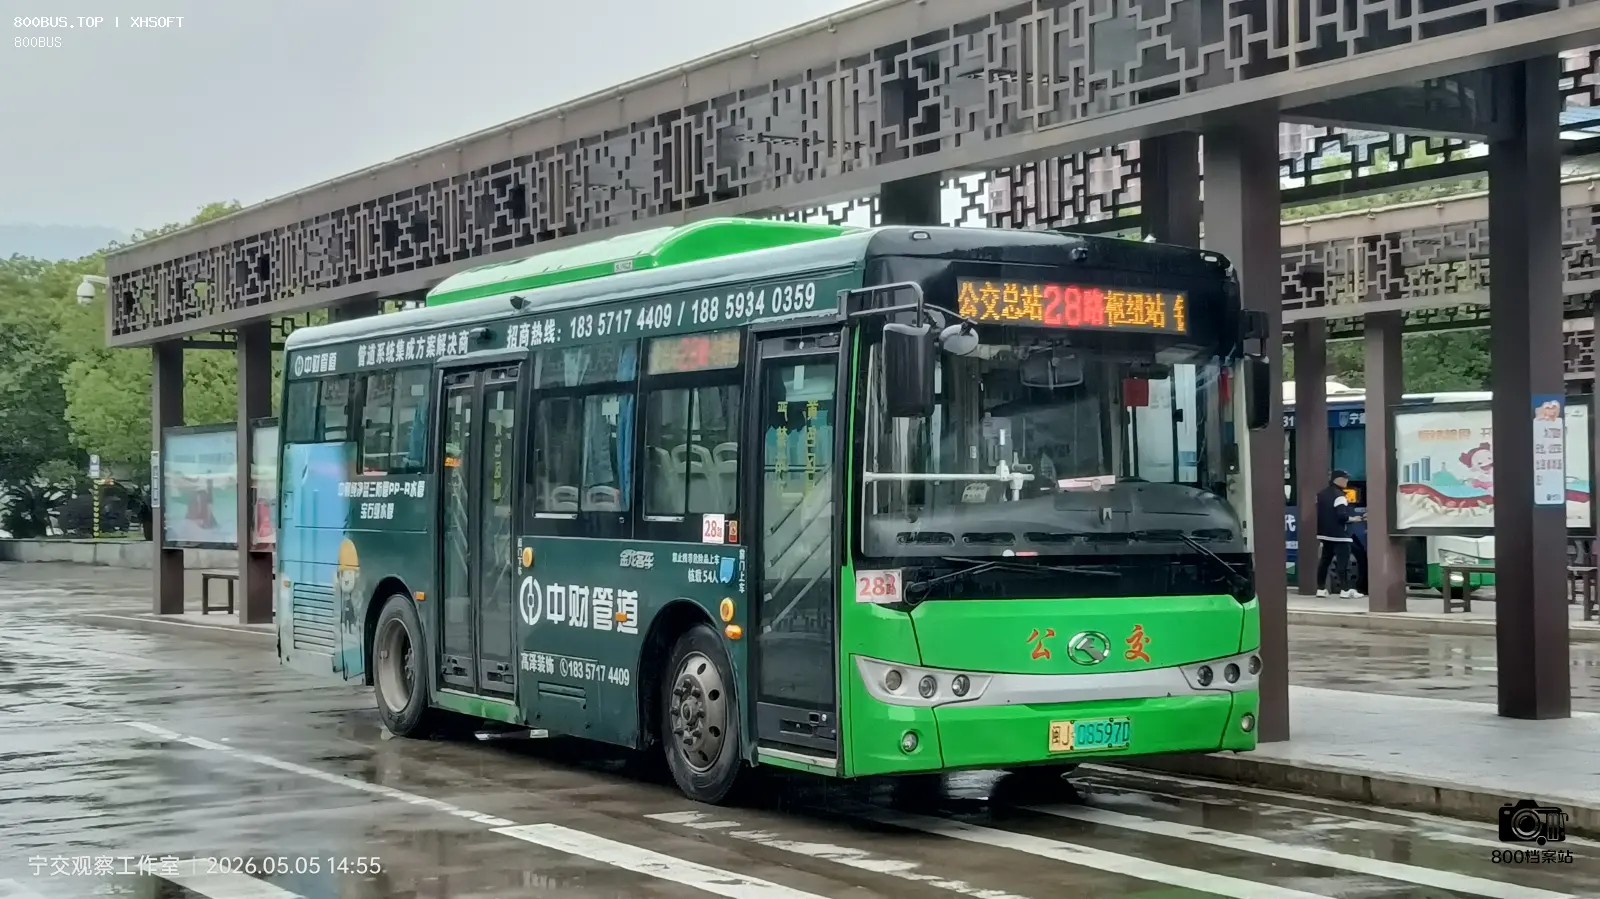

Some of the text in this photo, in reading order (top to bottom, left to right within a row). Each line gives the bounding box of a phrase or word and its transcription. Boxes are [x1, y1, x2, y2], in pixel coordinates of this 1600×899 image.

[570, 313, 593, 339] 183
[597, 308, 632, 336] 5717
[637, 303, 672, 331] 4409
[692, 295, 719, 324] 188
[725, 290, 765, 320] 5934
[771, 282, 816, 314] 0359
[304, 352, 337, 373] 中财管道
[358, 330, 470, 367] 管道系统集成方案解决商
[546, 582, 638, 635] 中财管道
[1026, 624, 1151, 662] 公 交
[568, 660, 584, 679] 183
[585, 662, 606, 682] 5717
[608, 666, 630, 686] 4409
